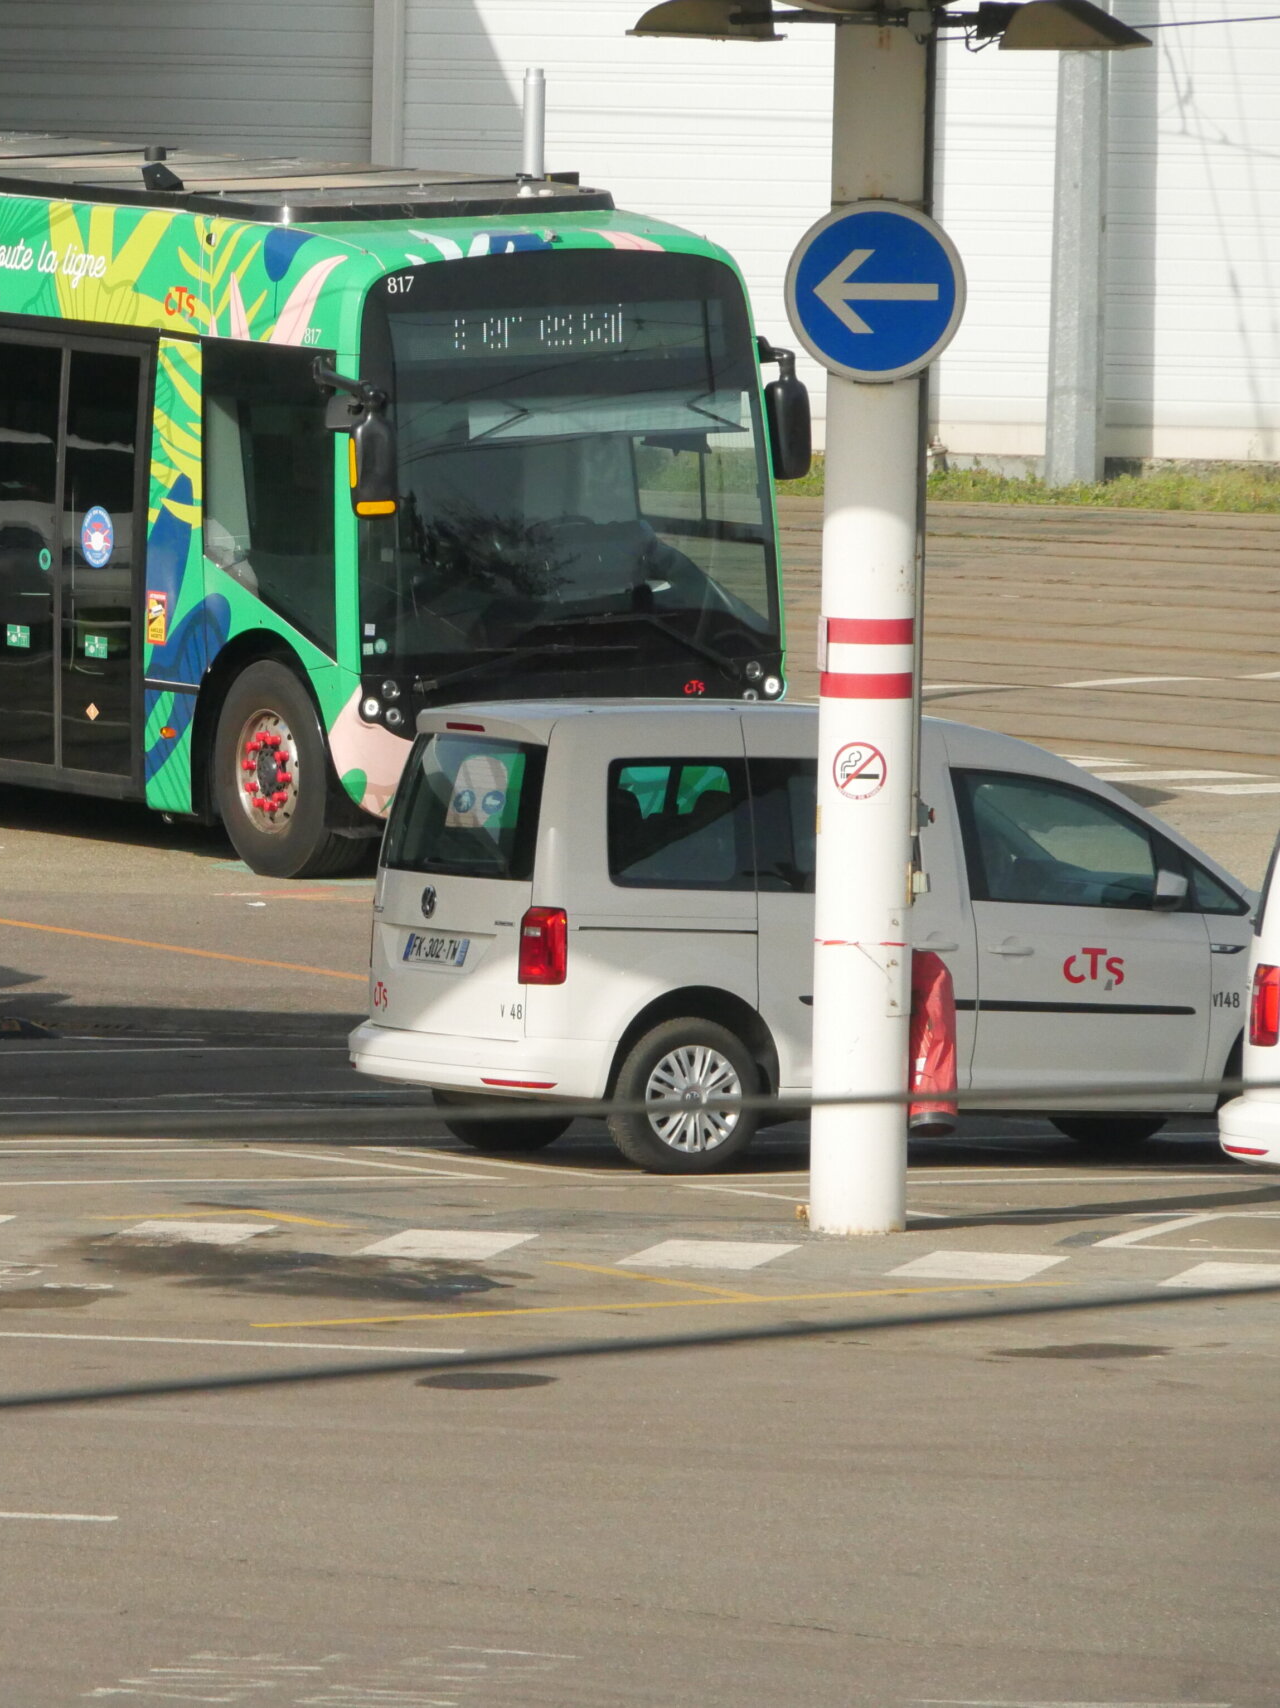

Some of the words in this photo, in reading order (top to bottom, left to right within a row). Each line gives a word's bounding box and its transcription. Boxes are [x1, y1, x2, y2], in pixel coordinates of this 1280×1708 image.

[37, 240, 58, 274] la
[63, 243, 107, 289] ligne
[387, 276, 415, 294] 817
[303, 328, 322, 345] 817
[1063, 947, 1125, 986] CTS
[510, 1003, 523, 1020] 48
